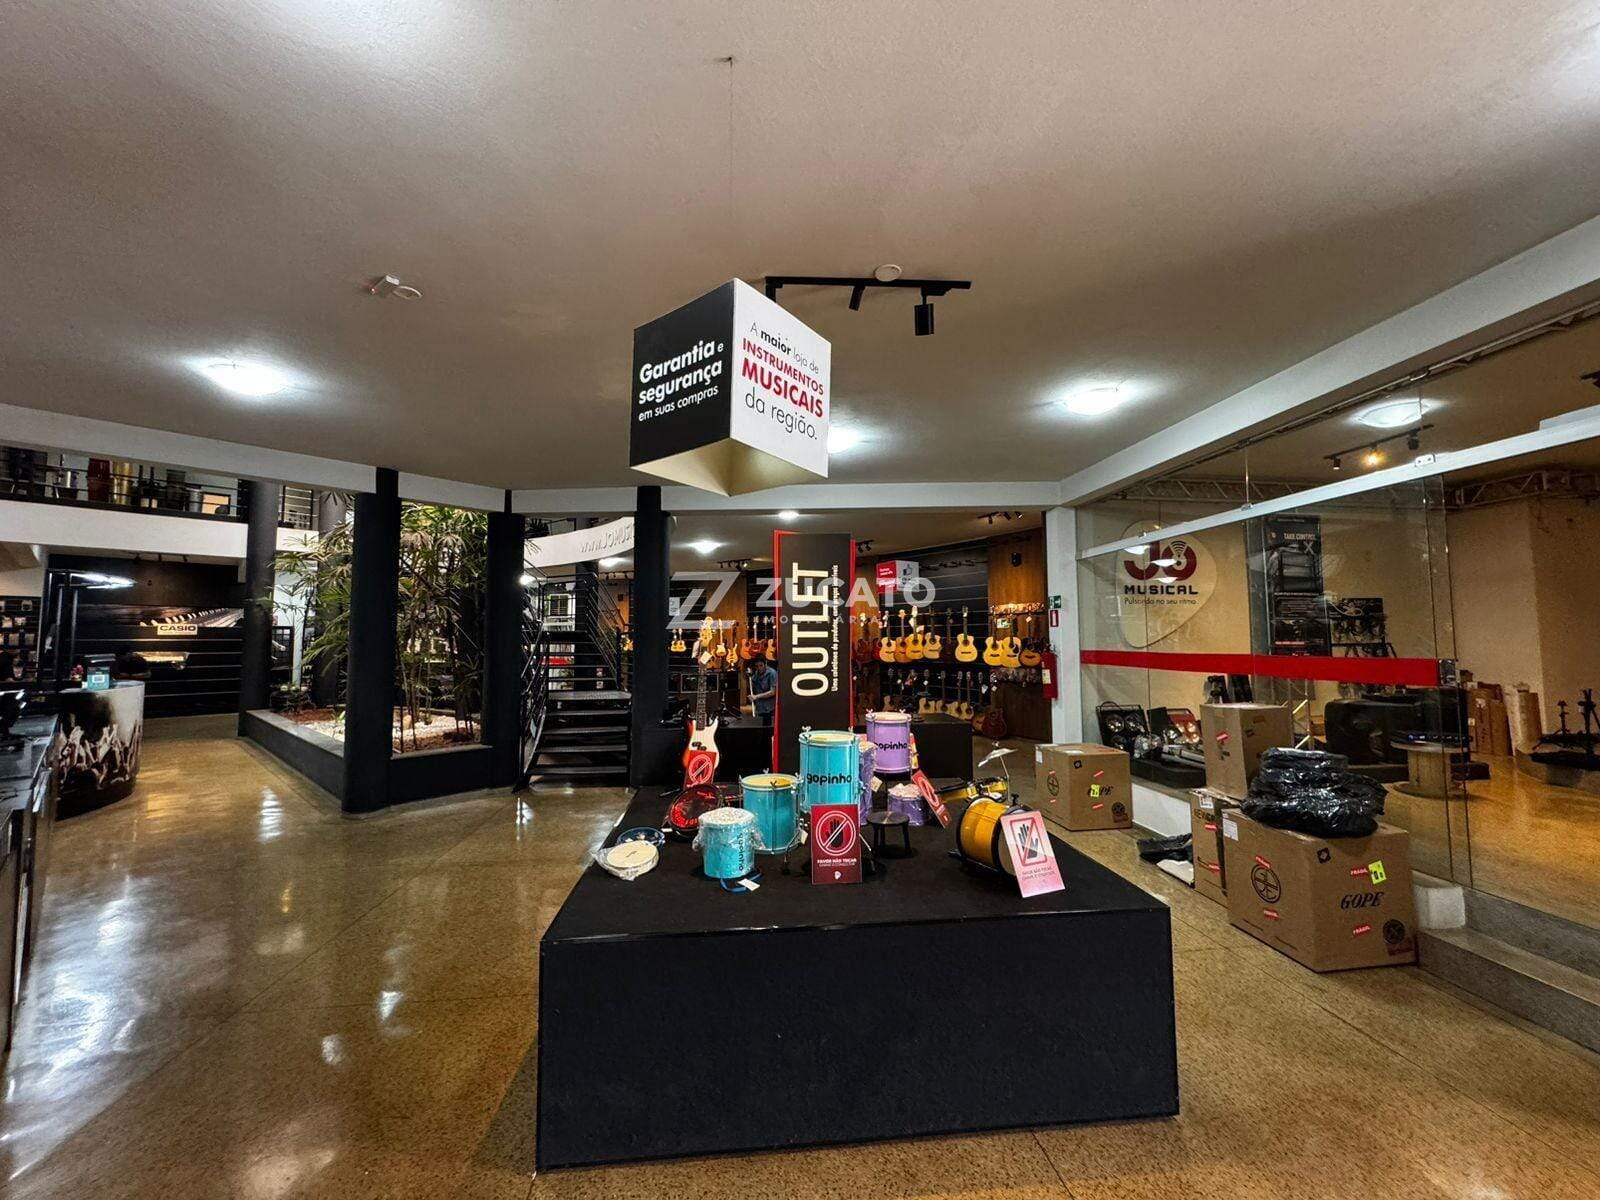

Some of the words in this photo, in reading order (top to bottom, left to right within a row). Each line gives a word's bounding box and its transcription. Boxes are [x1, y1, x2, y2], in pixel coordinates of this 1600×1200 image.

[639, 340, 715, 384] Garantia
[717, 343, 724, 353] e
[742, 337, 824, 396] INSTRUMENTOS
[750, 322, 758, 336] A
[760, 330, 791, 355] maior
[794, 347, 808, 367] loja
[809, 360, 819, 374] de
[638, 360, 722, 404] segurança
[638, 409, 653, 422] em
[654, 402, 675, 417] suas
[677, 385, 718, 409] compras
[741, 357, 823, 418] MUSICAIS
[745, 386, 765, 414] da
[771, 404, 817, 440] região.
[1124, 585, 1198, 595] MUSICAL
[791, 562, 829, 697] OUTLET
[874, 741, 908, 751] opinho
[806, 772, 852, 786] gopinho
[1340, 891, 1384, 910] GOPE
